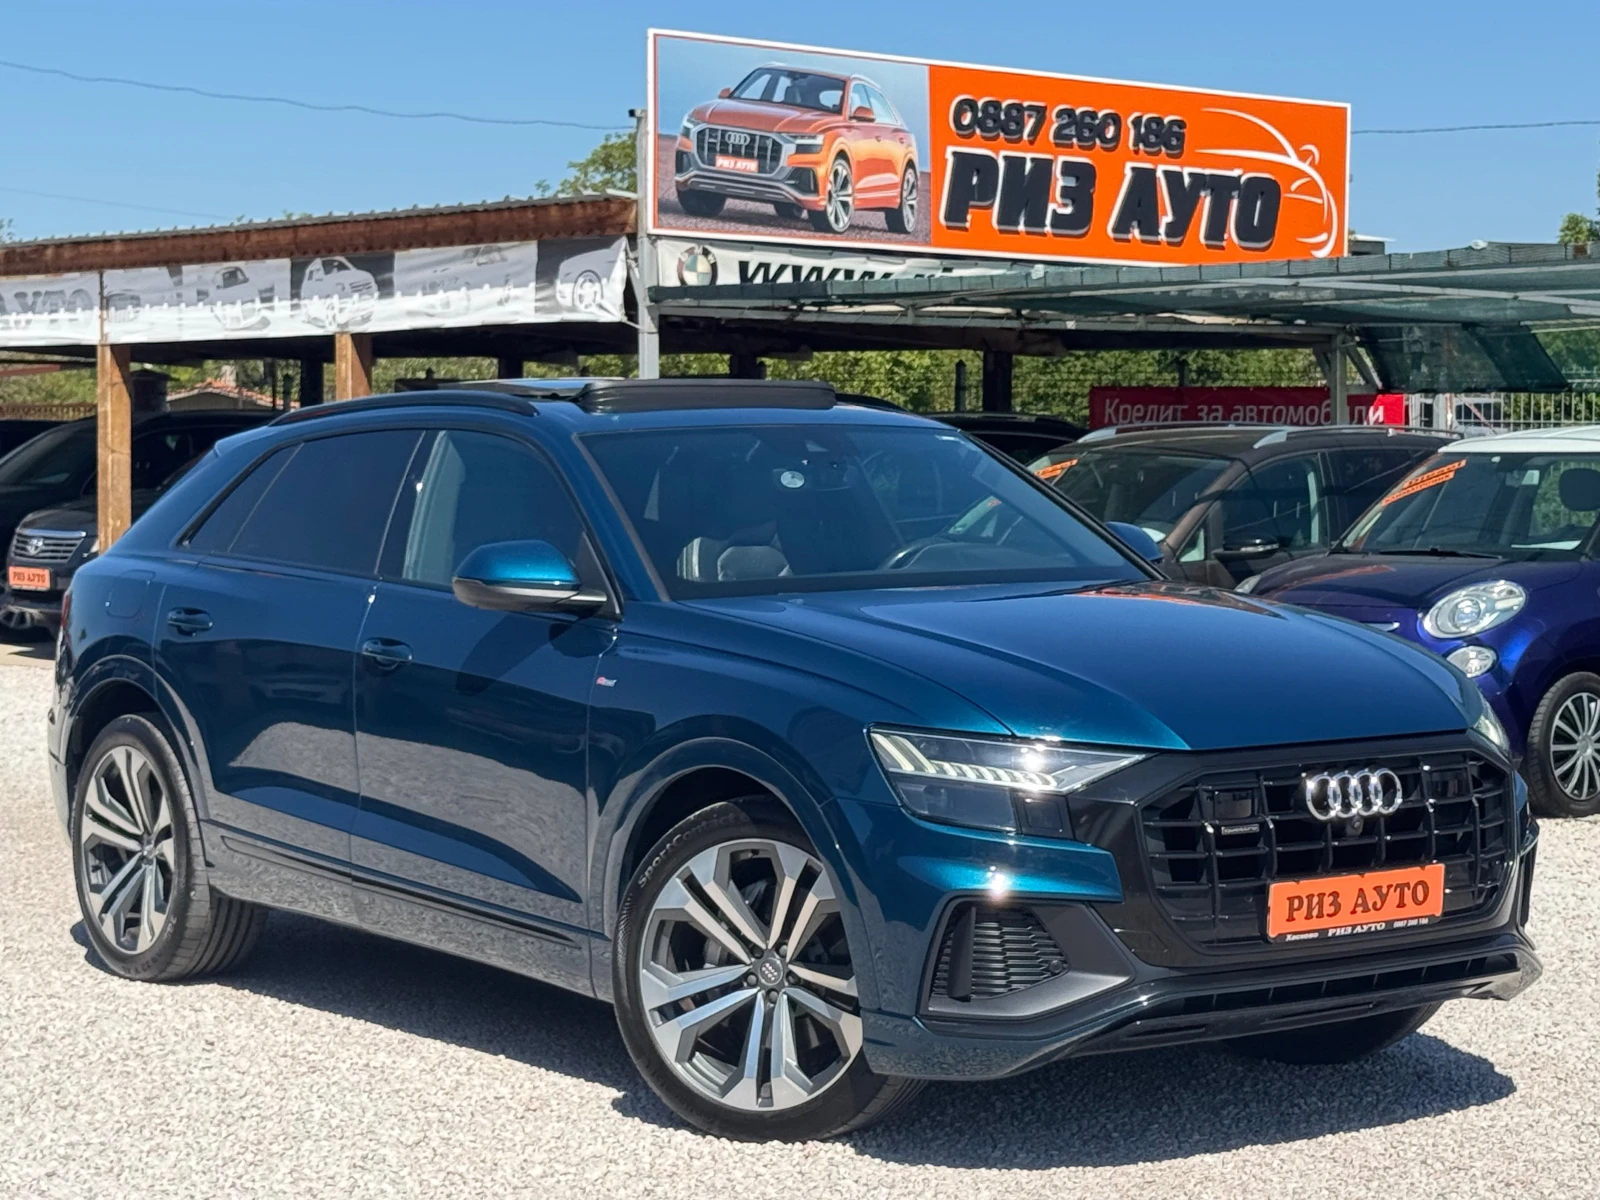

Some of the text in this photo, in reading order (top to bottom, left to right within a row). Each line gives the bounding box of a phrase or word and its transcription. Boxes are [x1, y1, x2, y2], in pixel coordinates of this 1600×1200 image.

[951, 95, 1187, 157] 0887 260 186
[940, 147, 1282, 251] РИЗ АУТО
[1104, 398, 1384, 426] Кредит за автомобли
[1285, 879, 1430, 922] РИЗ АУТО
[1327, 926, 1351, 937] РИЗ
[1353, 922, 1386, 934] АУТО
